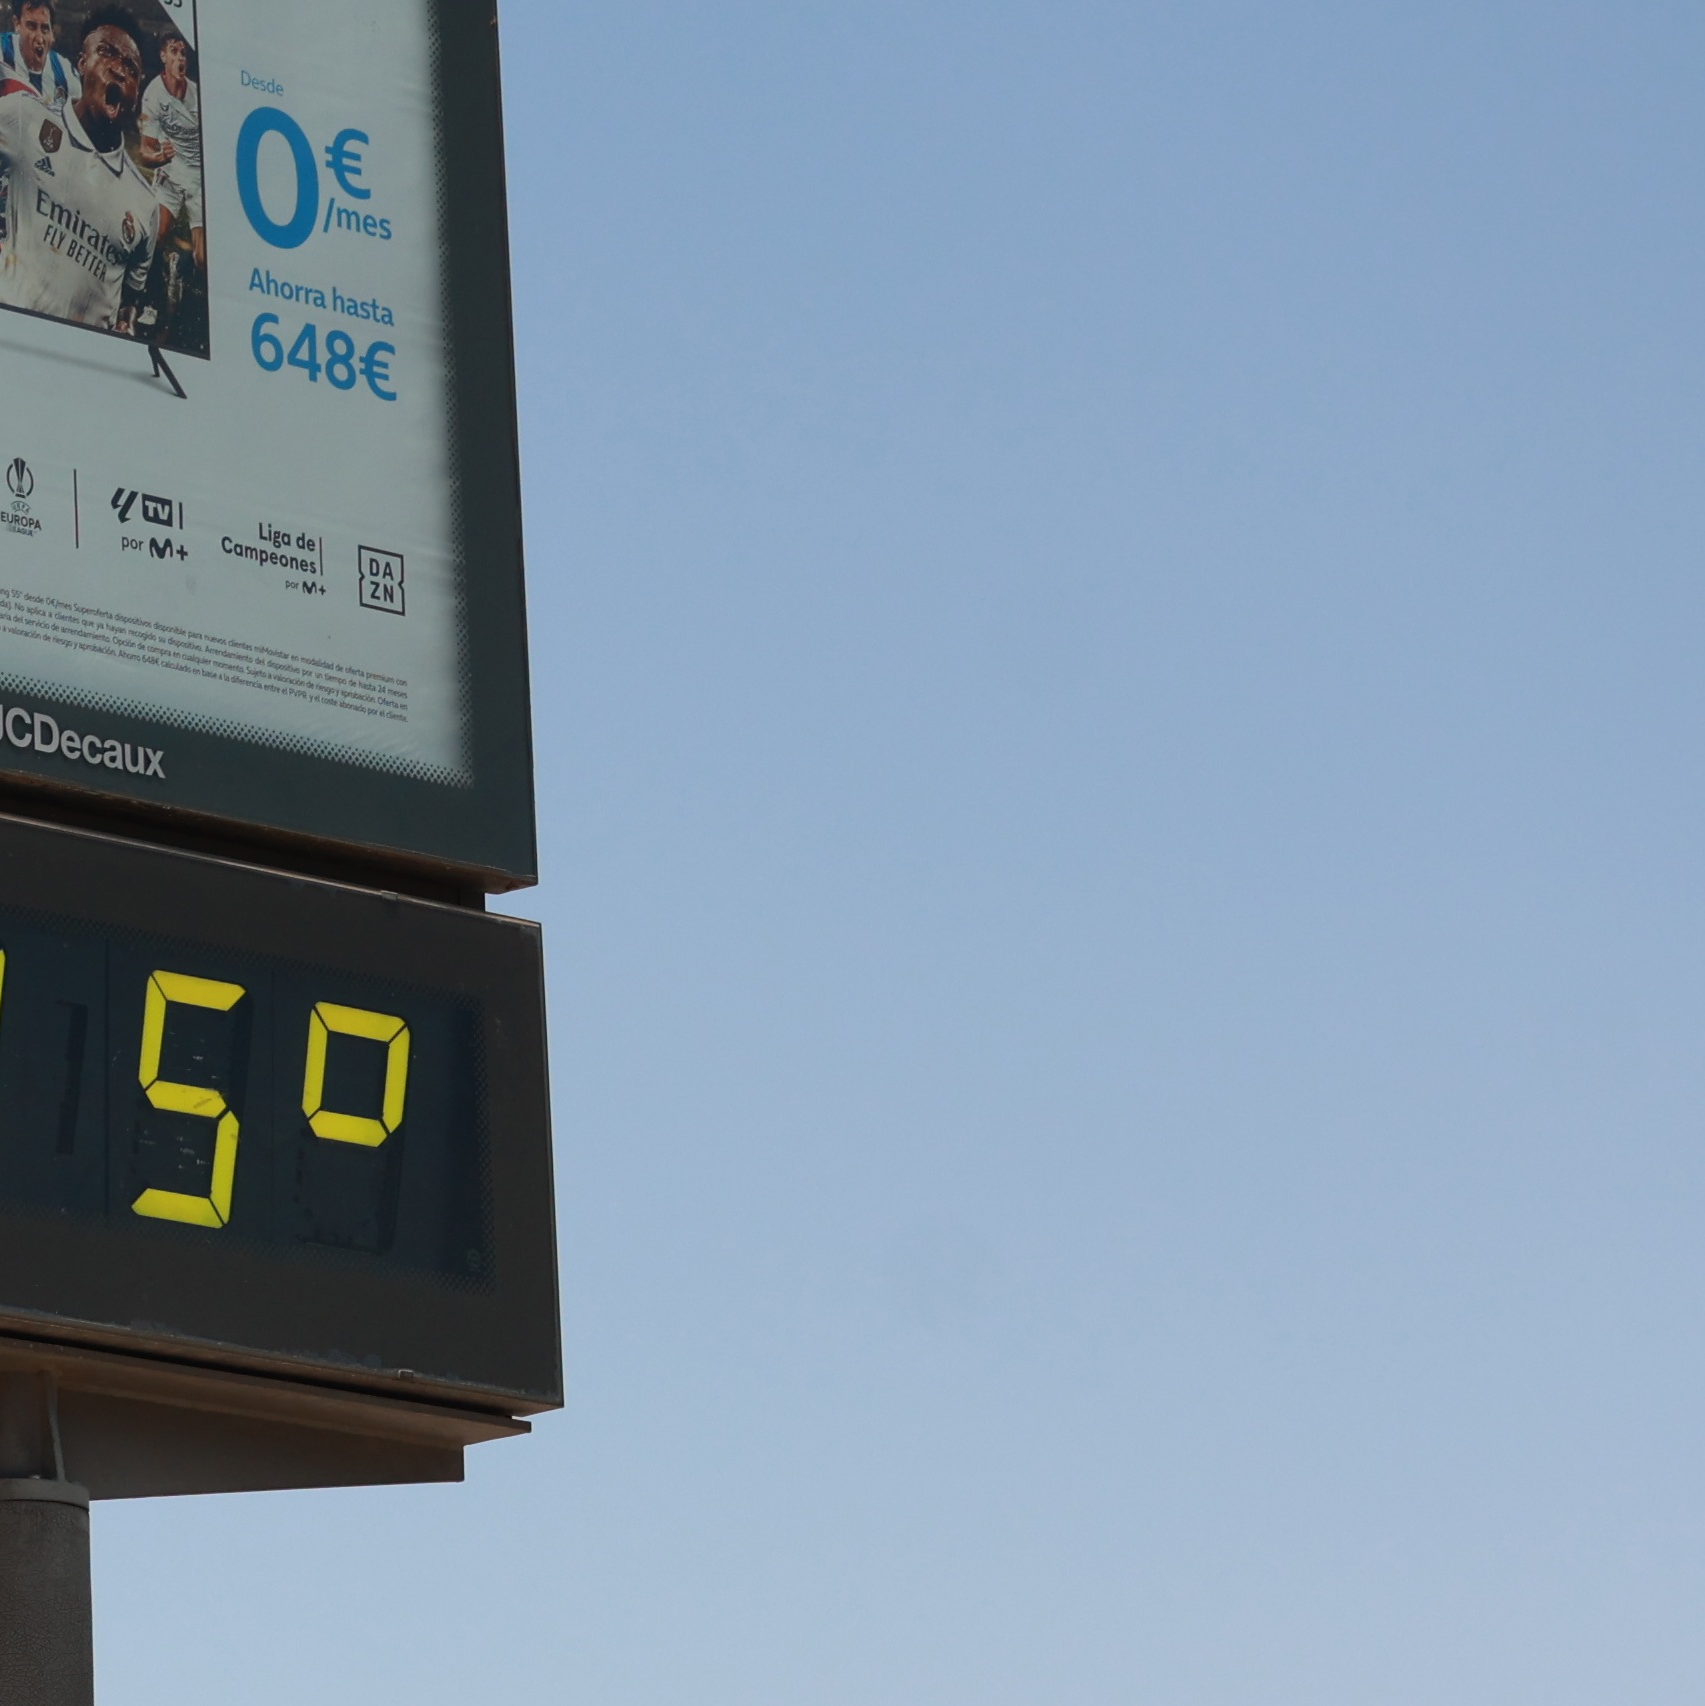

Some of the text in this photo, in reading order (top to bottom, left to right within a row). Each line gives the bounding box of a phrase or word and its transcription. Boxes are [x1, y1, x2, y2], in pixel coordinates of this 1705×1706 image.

[241, 70, 283, 96] Desde
[36, 188, 119, 266] Emirates
[43, 224, 107, 282] FLY BETTER
[249, 267, 394, 327] Ahorra hasta
[251, 312, 397, 401] 648€
[0, 511, 42, 530] EUROPA
[145, 499, 170, 521] TV
[121, 536, 144, 551] por
[258, 522, 316, 552] Liga de
[221, 536, 317, 575] Campeones
[285, 579, 300, 592] por
